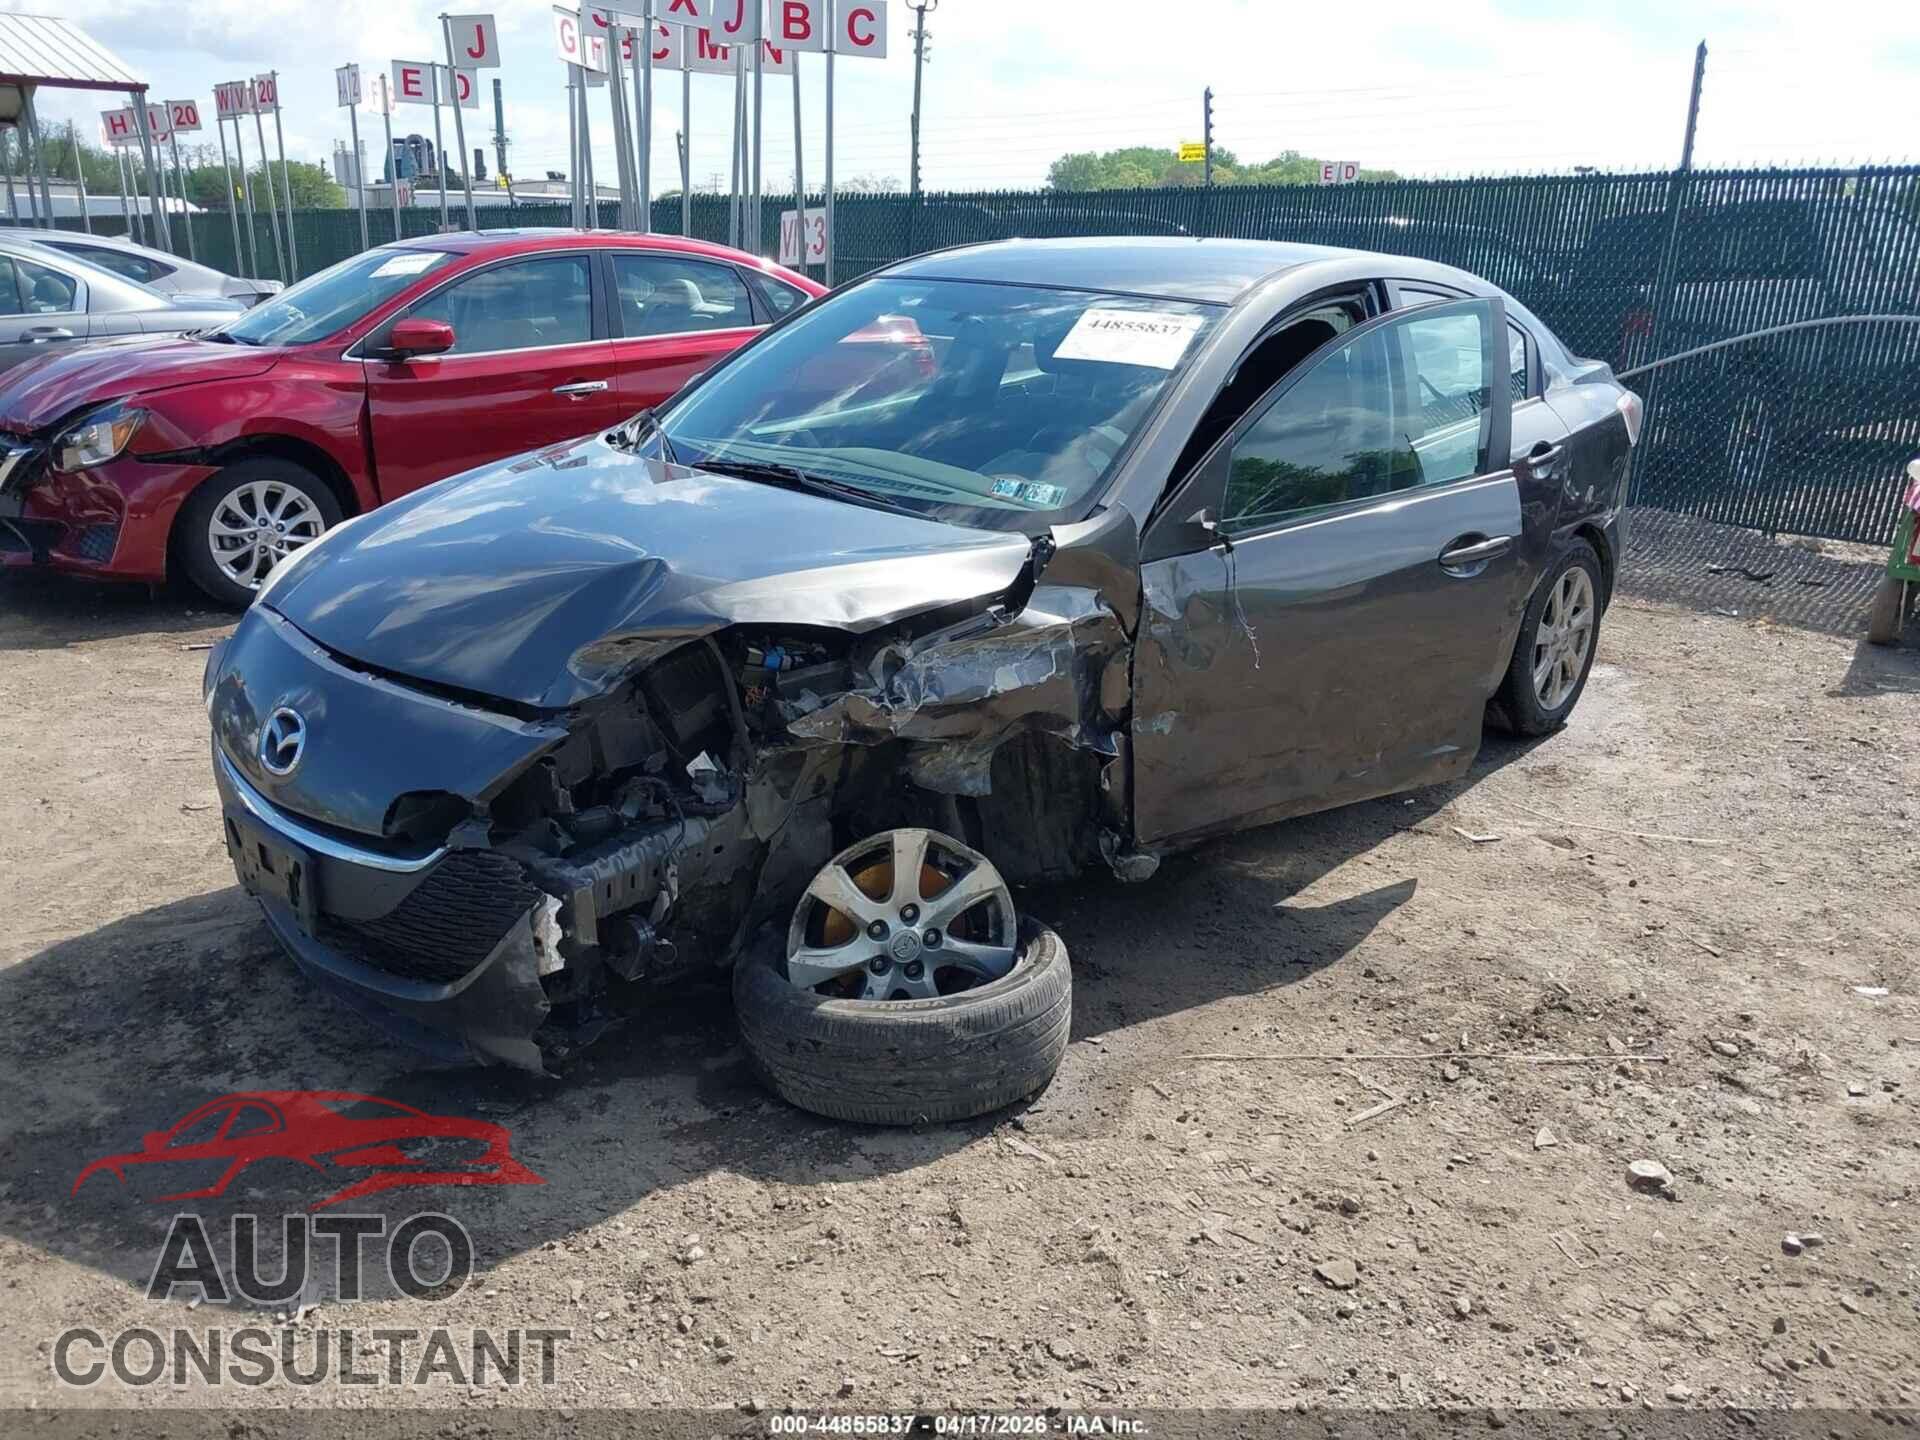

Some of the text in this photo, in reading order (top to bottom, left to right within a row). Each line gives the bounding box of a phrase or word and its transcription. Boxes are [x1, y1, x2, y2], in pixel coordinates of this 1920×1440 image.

[723, 0, 744, 33] J
[783, 1, 875, 46] B C
[467, 24, 486, 58] J
[560, 18, 576, 53] G
[258, 79, 274, 103] 20
[402, 68, 423, 97] E
[216, 88, 229, 111] W
[235, 87, 243, 109] V
[110, 114, 128, 135] H
[173, 105, 197, 126] 20
[1324, 165, 1356, 180] E D
[1088, 318, 1182, 336] 44855837
